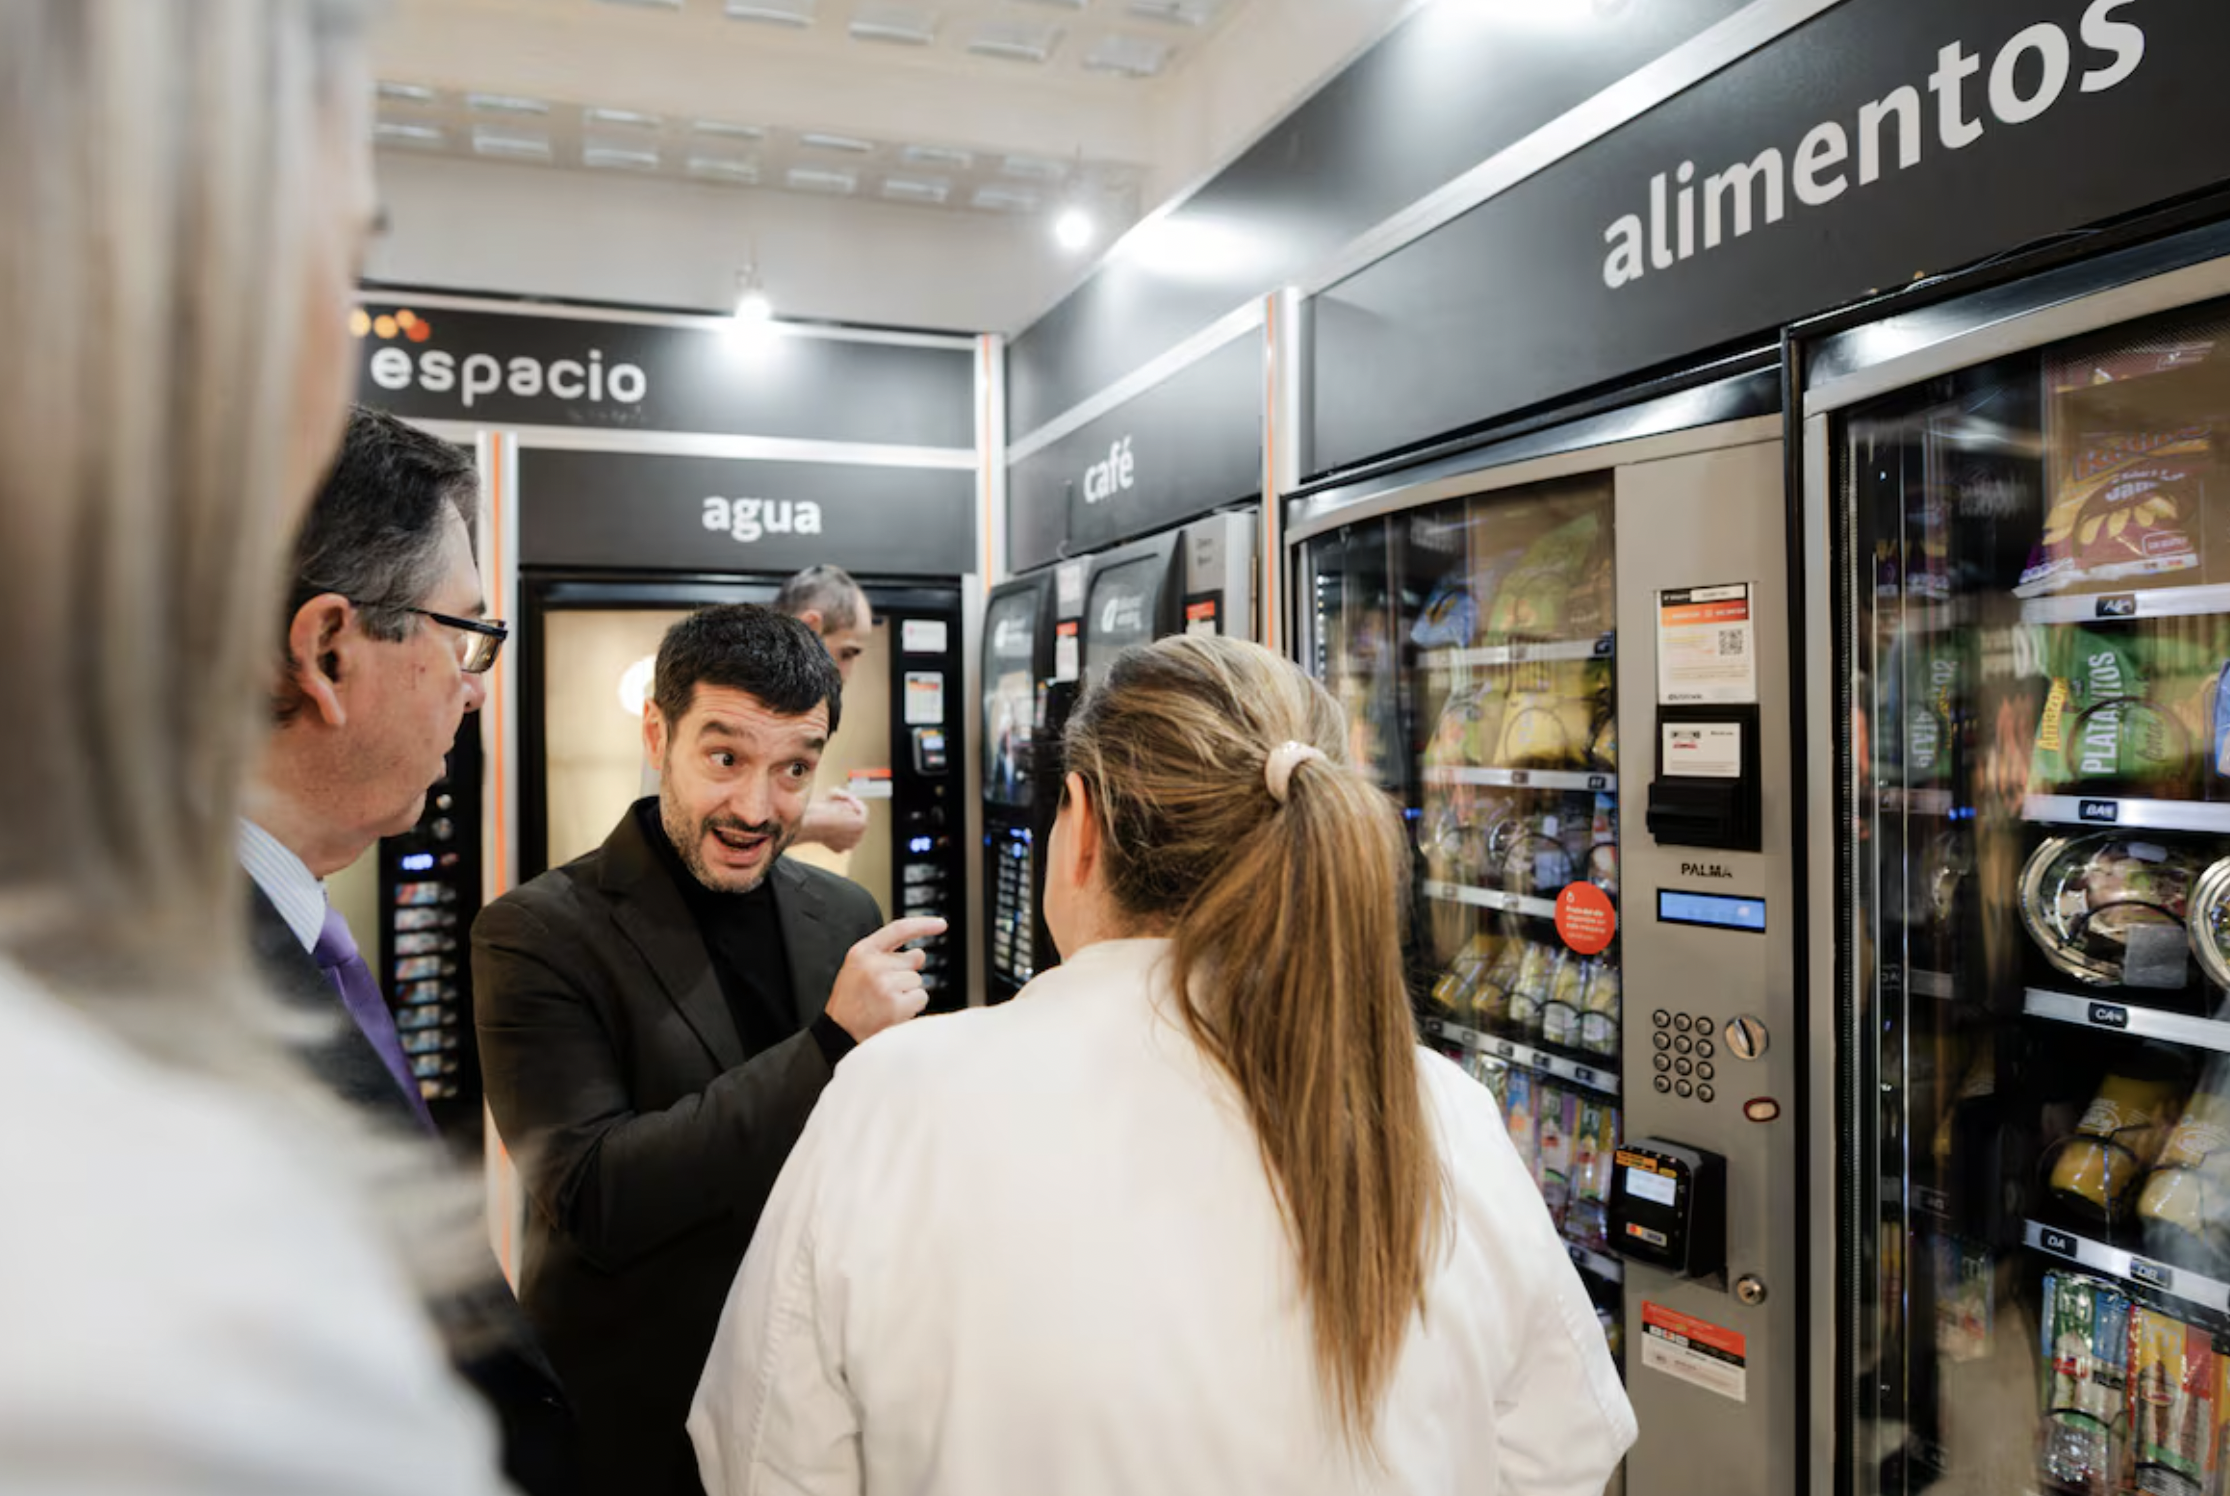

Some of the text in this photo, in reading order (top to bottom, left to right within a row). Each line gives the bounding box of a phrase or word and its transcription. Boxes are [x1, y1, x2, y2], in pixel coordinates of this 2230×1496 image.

[1602, 0, 2145, 290] alimentos
[370, 346, 648, 408] espacio
[1083, 434, 1134, 504] café
[702, 495, 822, 542] agua
[1681, 863, 1734, 878] PALMA
